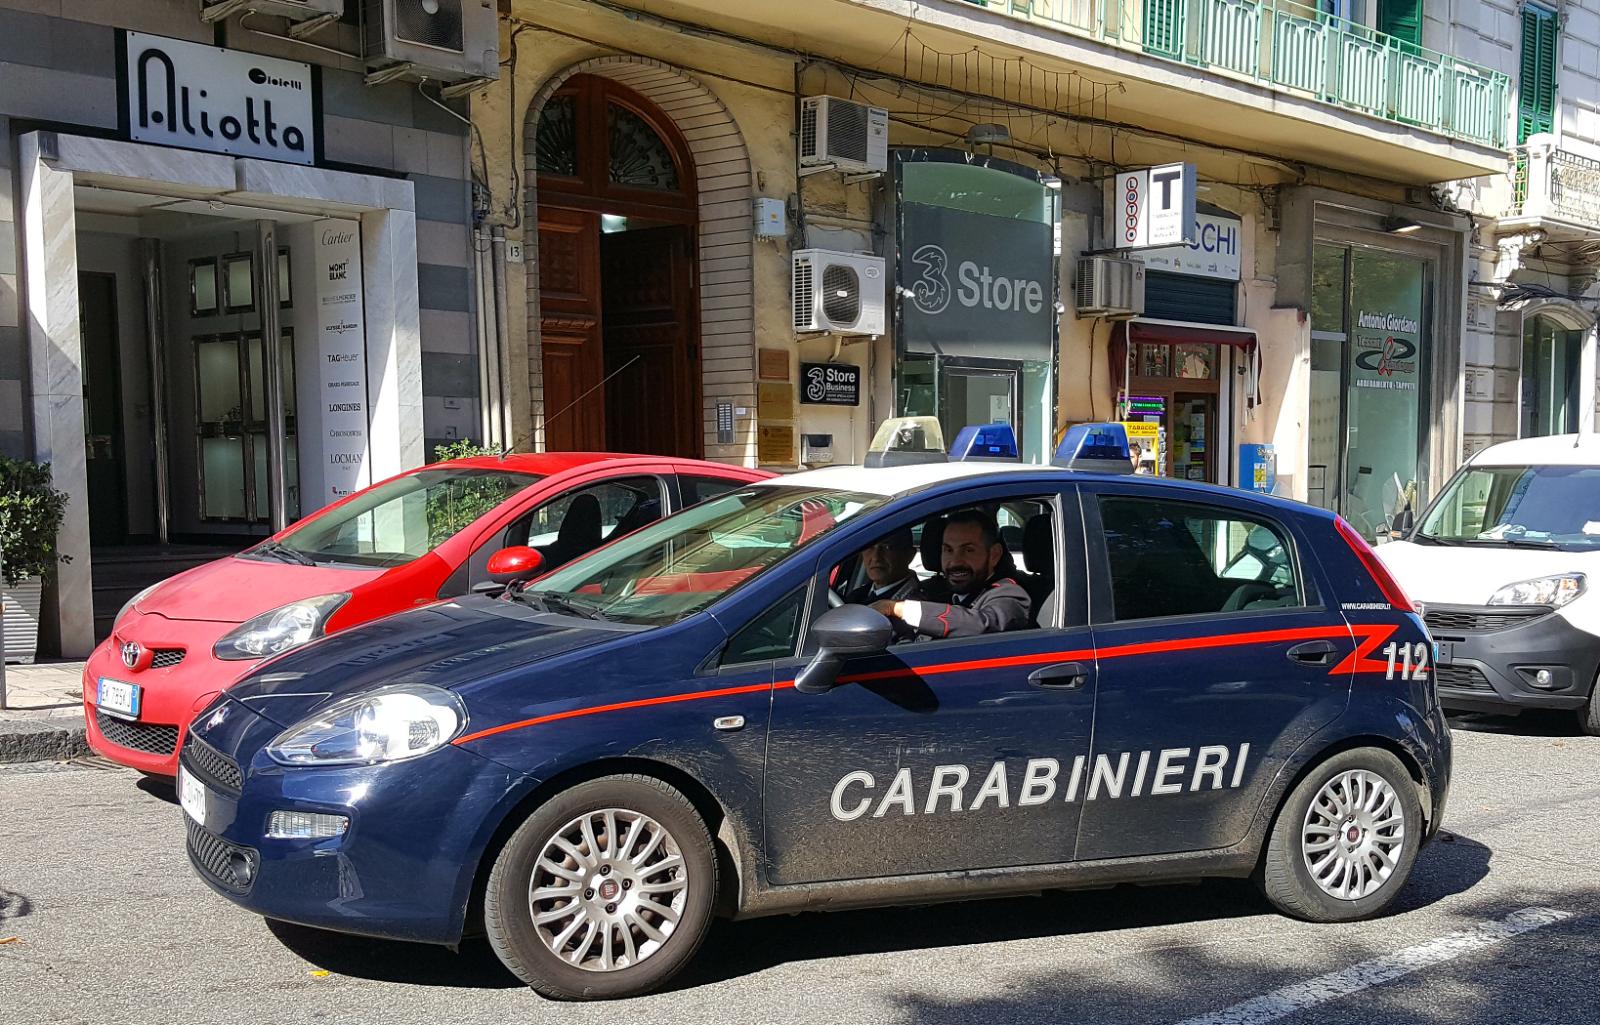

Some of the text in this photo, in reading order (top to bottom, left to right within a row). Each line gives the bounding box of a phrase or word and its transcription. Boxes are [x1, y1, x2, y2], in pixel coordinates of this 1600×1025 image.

[248, 68, 302, 90] Gioielli
[137, 48, 305, 151] Aliotta
[1153, 170, 1181, 210] T
[321, 228, 354, 246] Cartier
[510, 246, 520, 257] 13
[328, 263, 347, 272] MONT
[957, 261, 1043, 314] Store
[1357, 311, 1417, 334] Antonio Giordano
[826, 368, 856, 382] Store
[826, 382, 855, 392] Business
[329, 402, 361, 412] LONGINES
[1383, 641, 1428, 681] 112
[830, 742, 1251, 822] CARABINIERI
